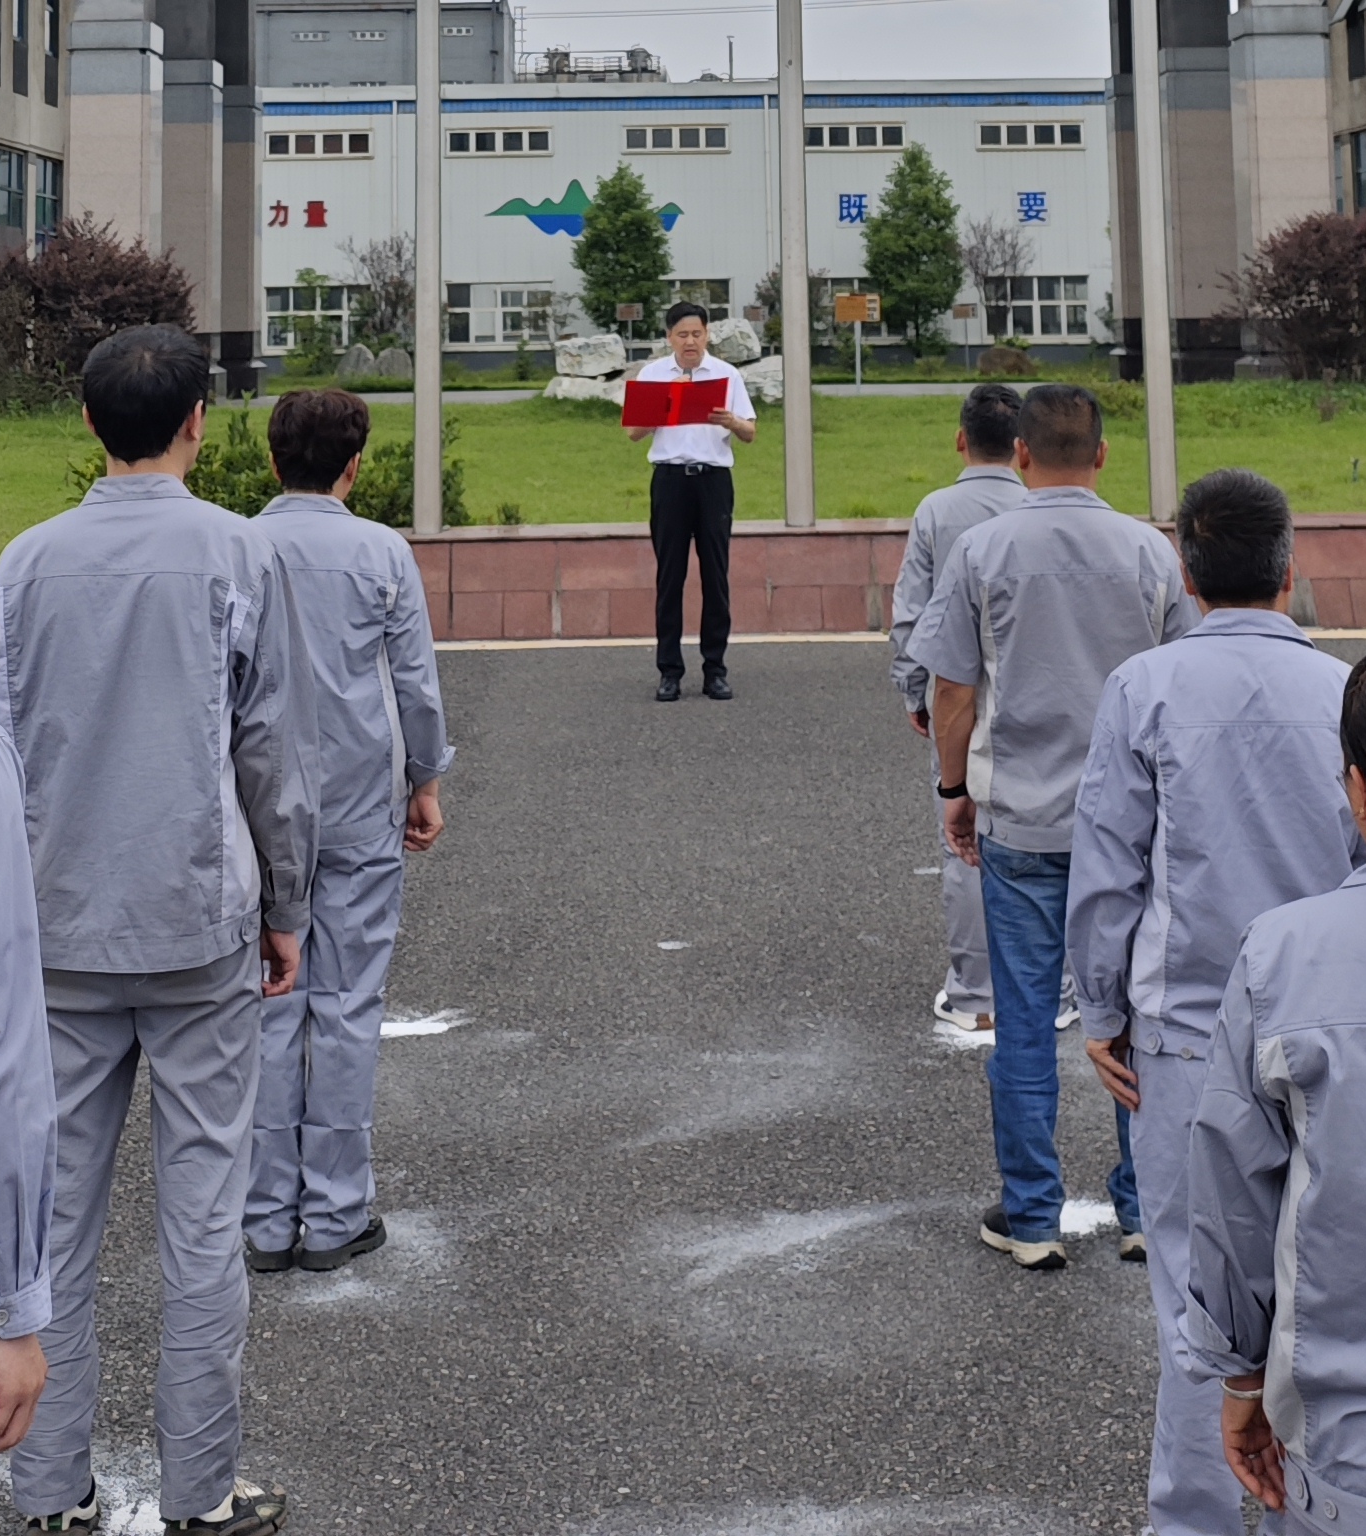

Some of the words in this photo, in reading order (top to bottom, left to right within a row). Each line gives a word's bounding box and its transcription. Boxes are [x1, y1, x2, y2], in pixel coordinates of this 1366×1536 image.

[267, 199, 328, 228] 力量
[838, 193, 869, 224] 既
[1016, 191, 1048, 223] 要
